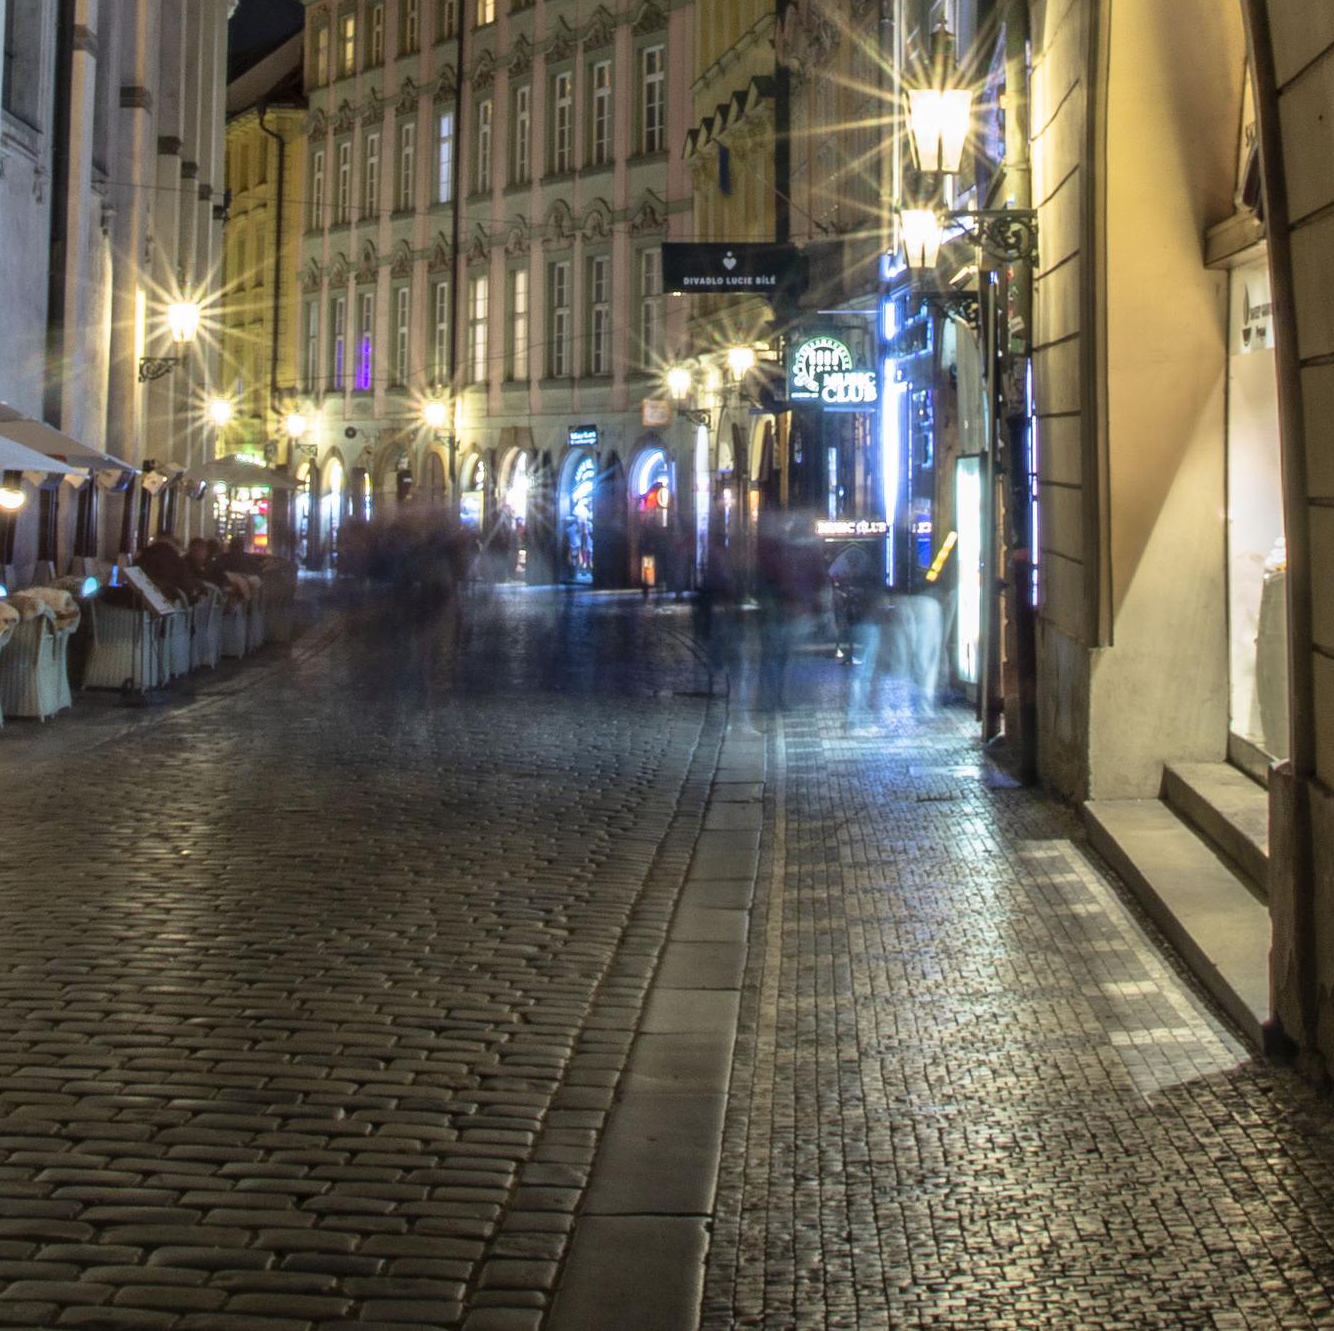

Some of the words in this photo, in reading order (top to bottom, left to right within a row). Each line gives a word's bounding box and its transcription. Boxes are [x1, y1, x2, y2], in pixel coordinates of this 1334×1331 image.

[683, 276, 724, 285] DIVADLO
[726, 276, 753, 285] LUCIE
[755, 274, 777, 285] BÍLÉ
[823, 372, 876, 386] MUSIC
[822, 385, 877, 403] CLUB
